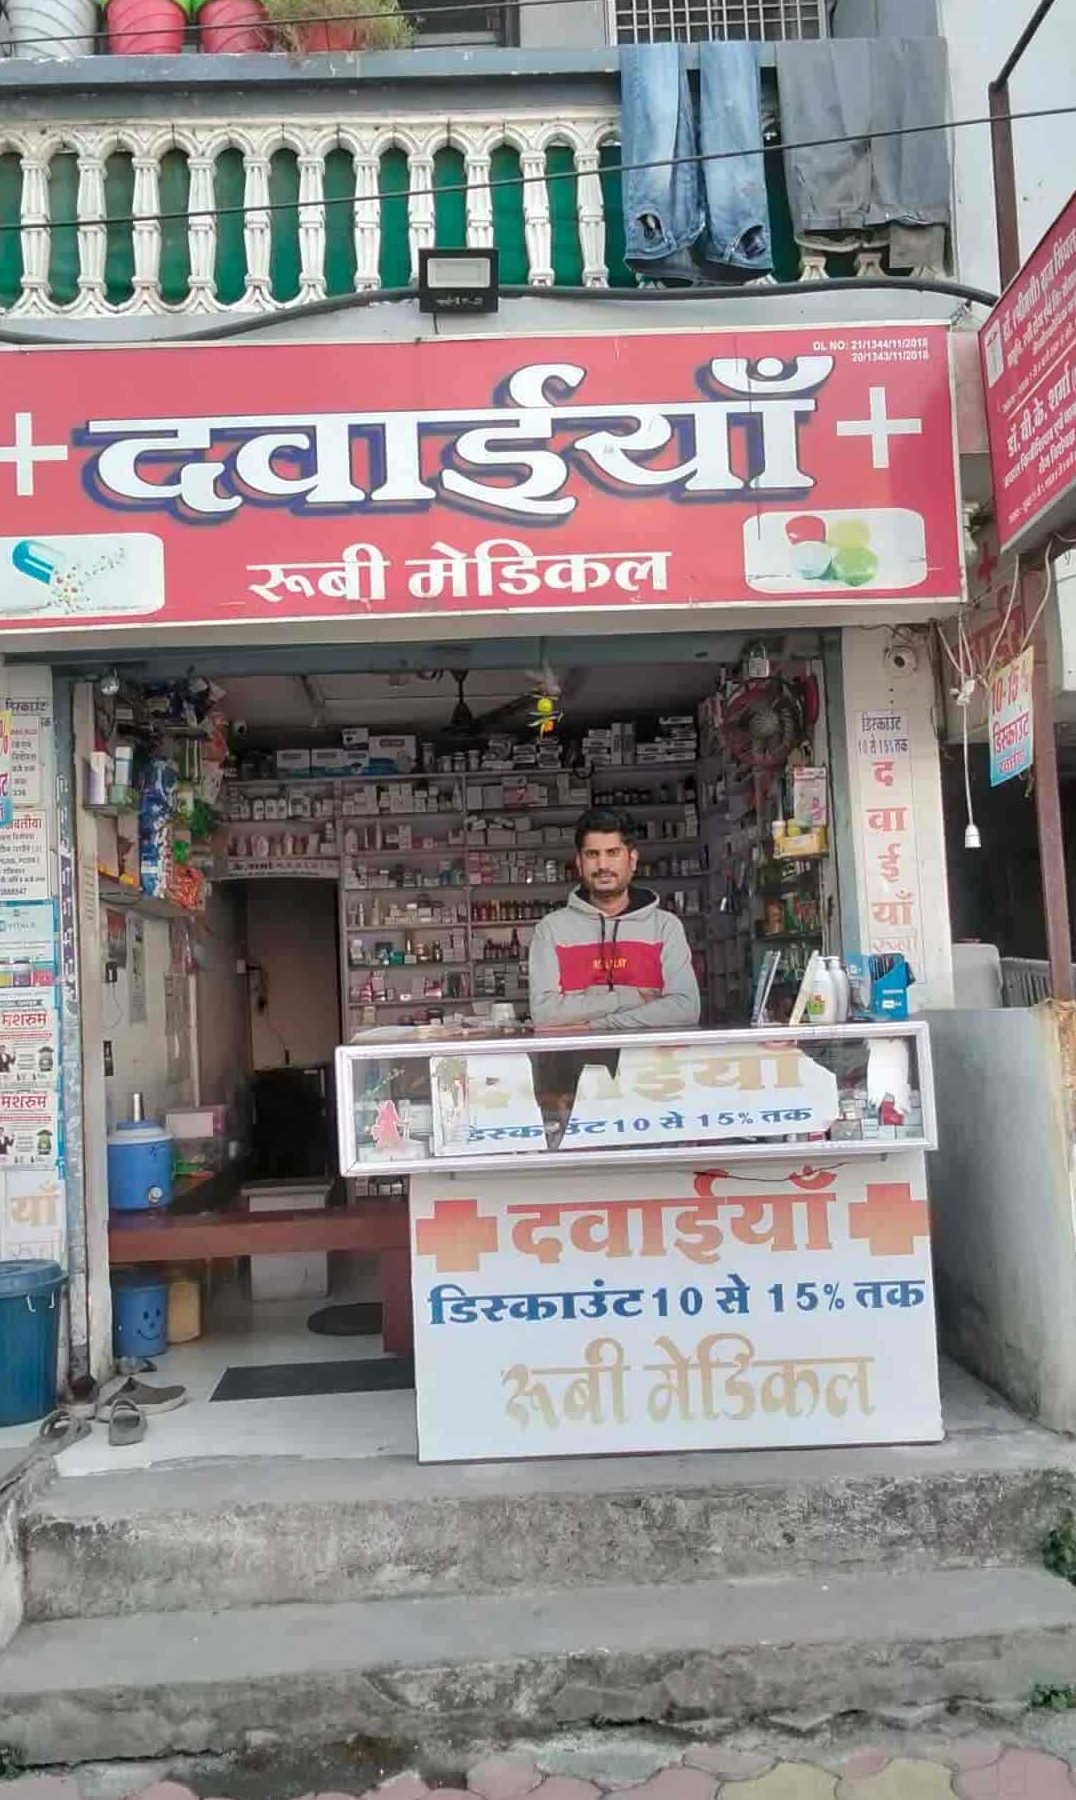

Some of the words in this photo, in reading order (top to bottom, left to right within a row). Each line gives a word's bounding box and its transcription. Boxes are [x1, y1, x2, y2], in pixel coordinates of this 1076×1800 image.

[813, 340, 827, 351] DL
[829, 339, 848, 351] NO:
[86, 355, 834, 517] दवाईयाँ
[247, 543, 390, 604] रूबी
[405, 538, 672, 601] मेडिकल
[613, 1116, 650, 1133] 10
[659, 1110, 685, 1130] से
[697, 1110, 754, 1128] 15%
[759, 1107, 813, 1124] तक
[507, 1166, 837, 1265] दवाईयाँ
[427, 1279, 644, 1325] डिस्काउंट
[652, 1286, 703, 1318] 10
[715, 1274, 749, 1315] से
[767, 1281, 846, 1314] 15%
[853, 1278, 926, 1310] तक
